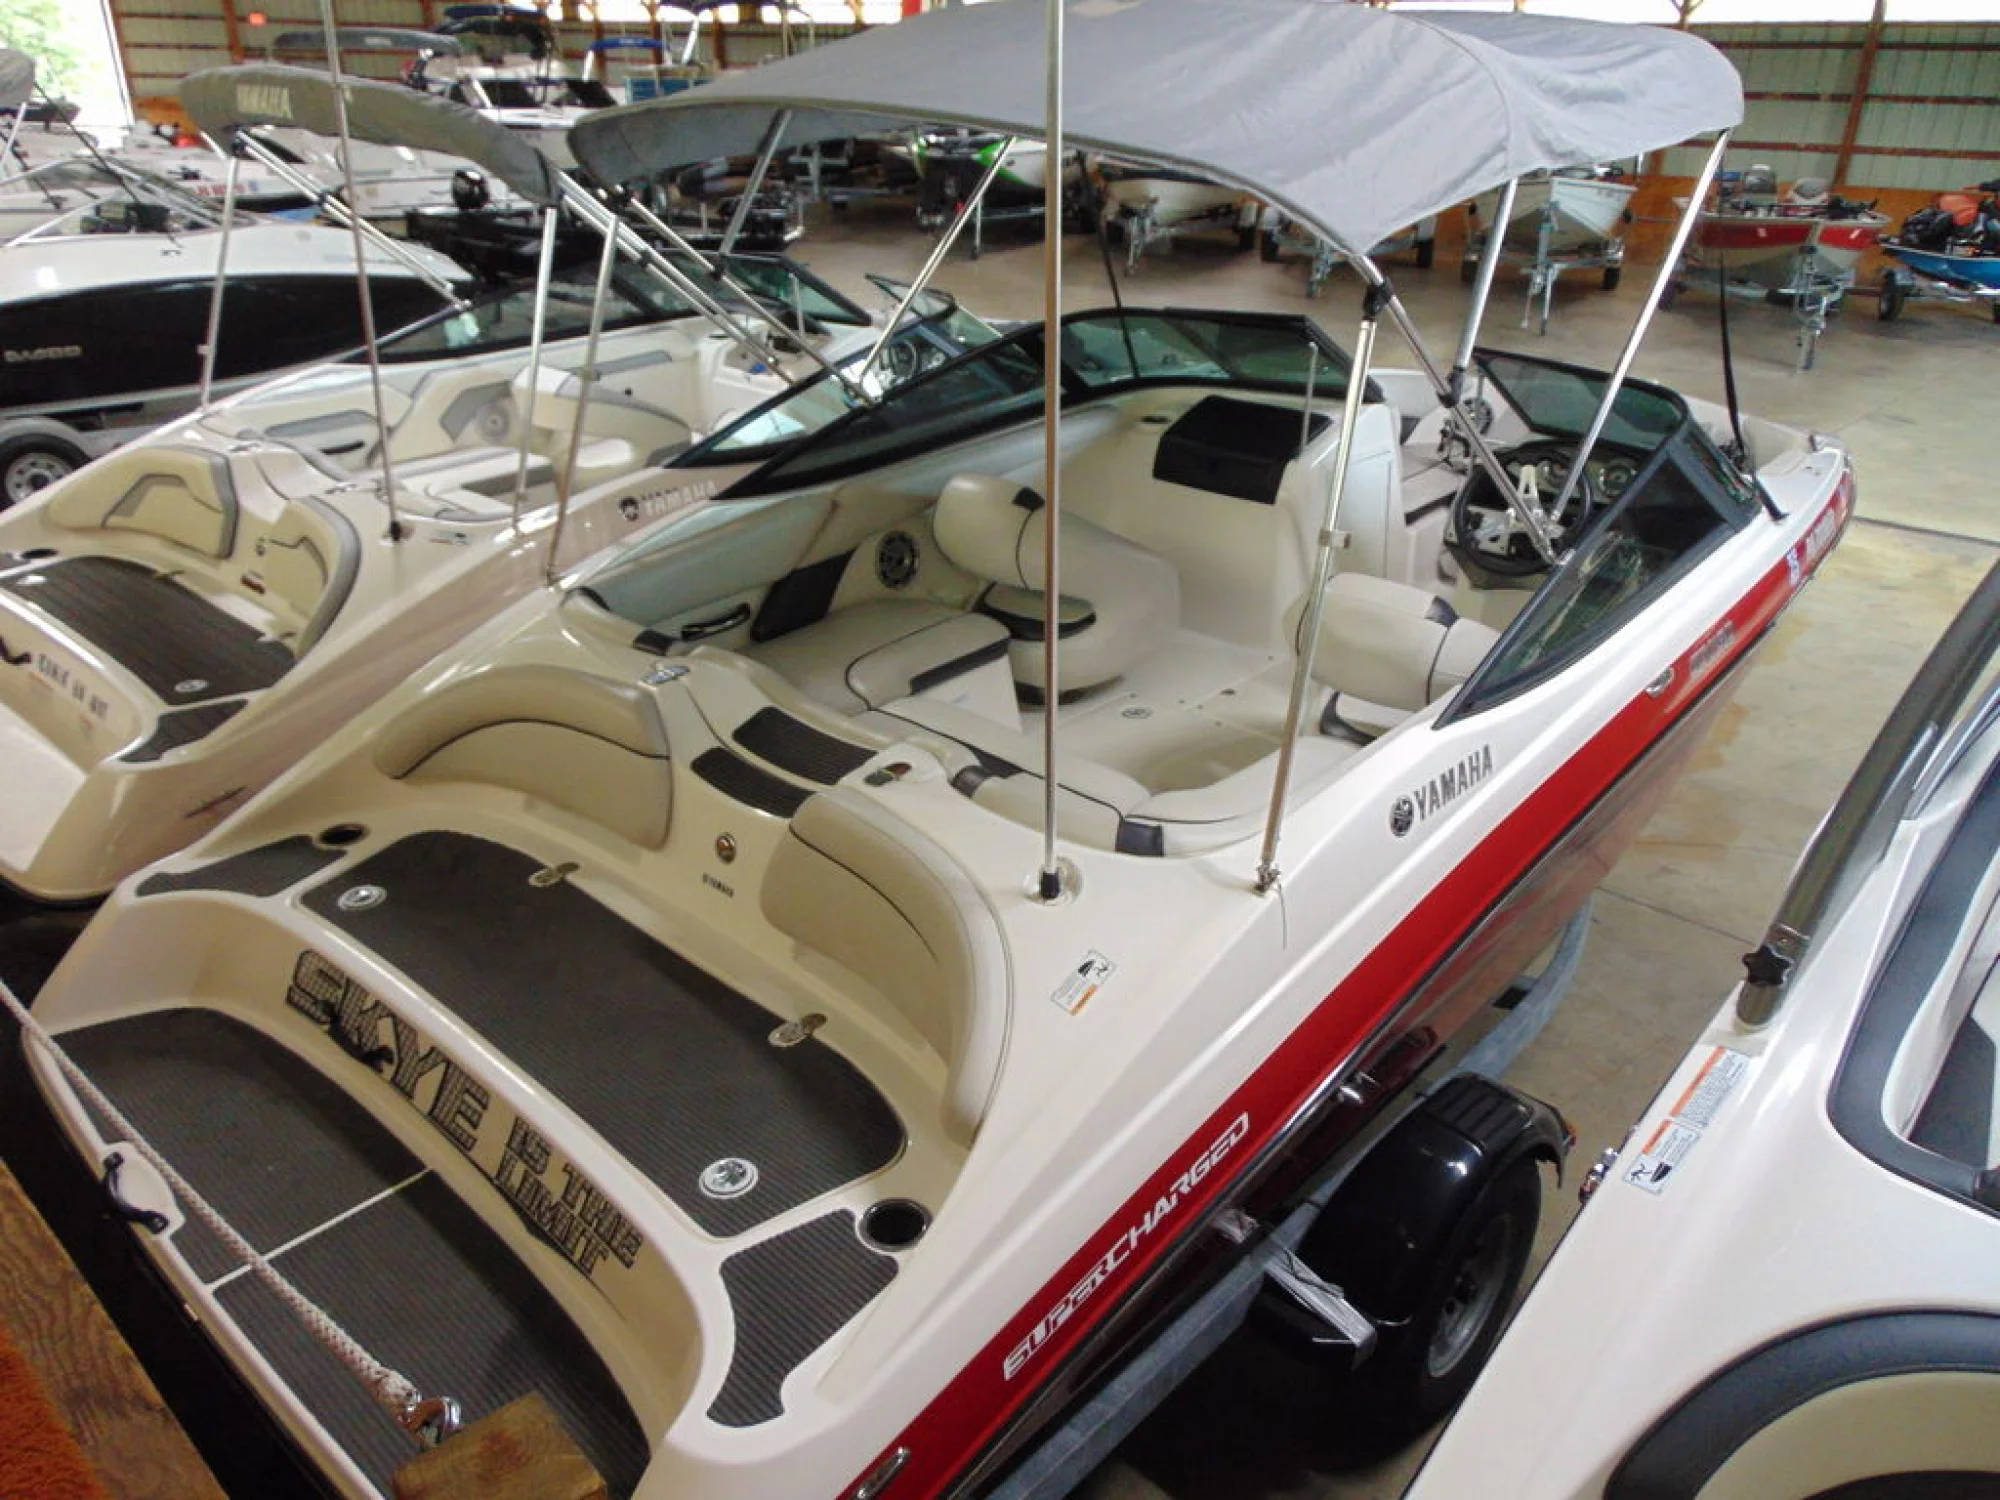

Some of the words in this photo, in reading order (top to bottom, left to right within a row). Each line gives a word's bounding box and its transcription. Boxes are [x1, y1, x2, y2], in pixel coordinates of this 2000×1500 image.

[640, 479, 718, 518] YAMAHA
[1413, 744, 1492, 821] YAMAHA
[285, 948, 491, 1152] SKYE
[494, 1151, 609, 1276] LIMIT
[506, 1116, 551, 1175] IS
[561, 1162, 645, 1269] THE
[1003, 1110, 1249, 1382] SUPERCHARGED
